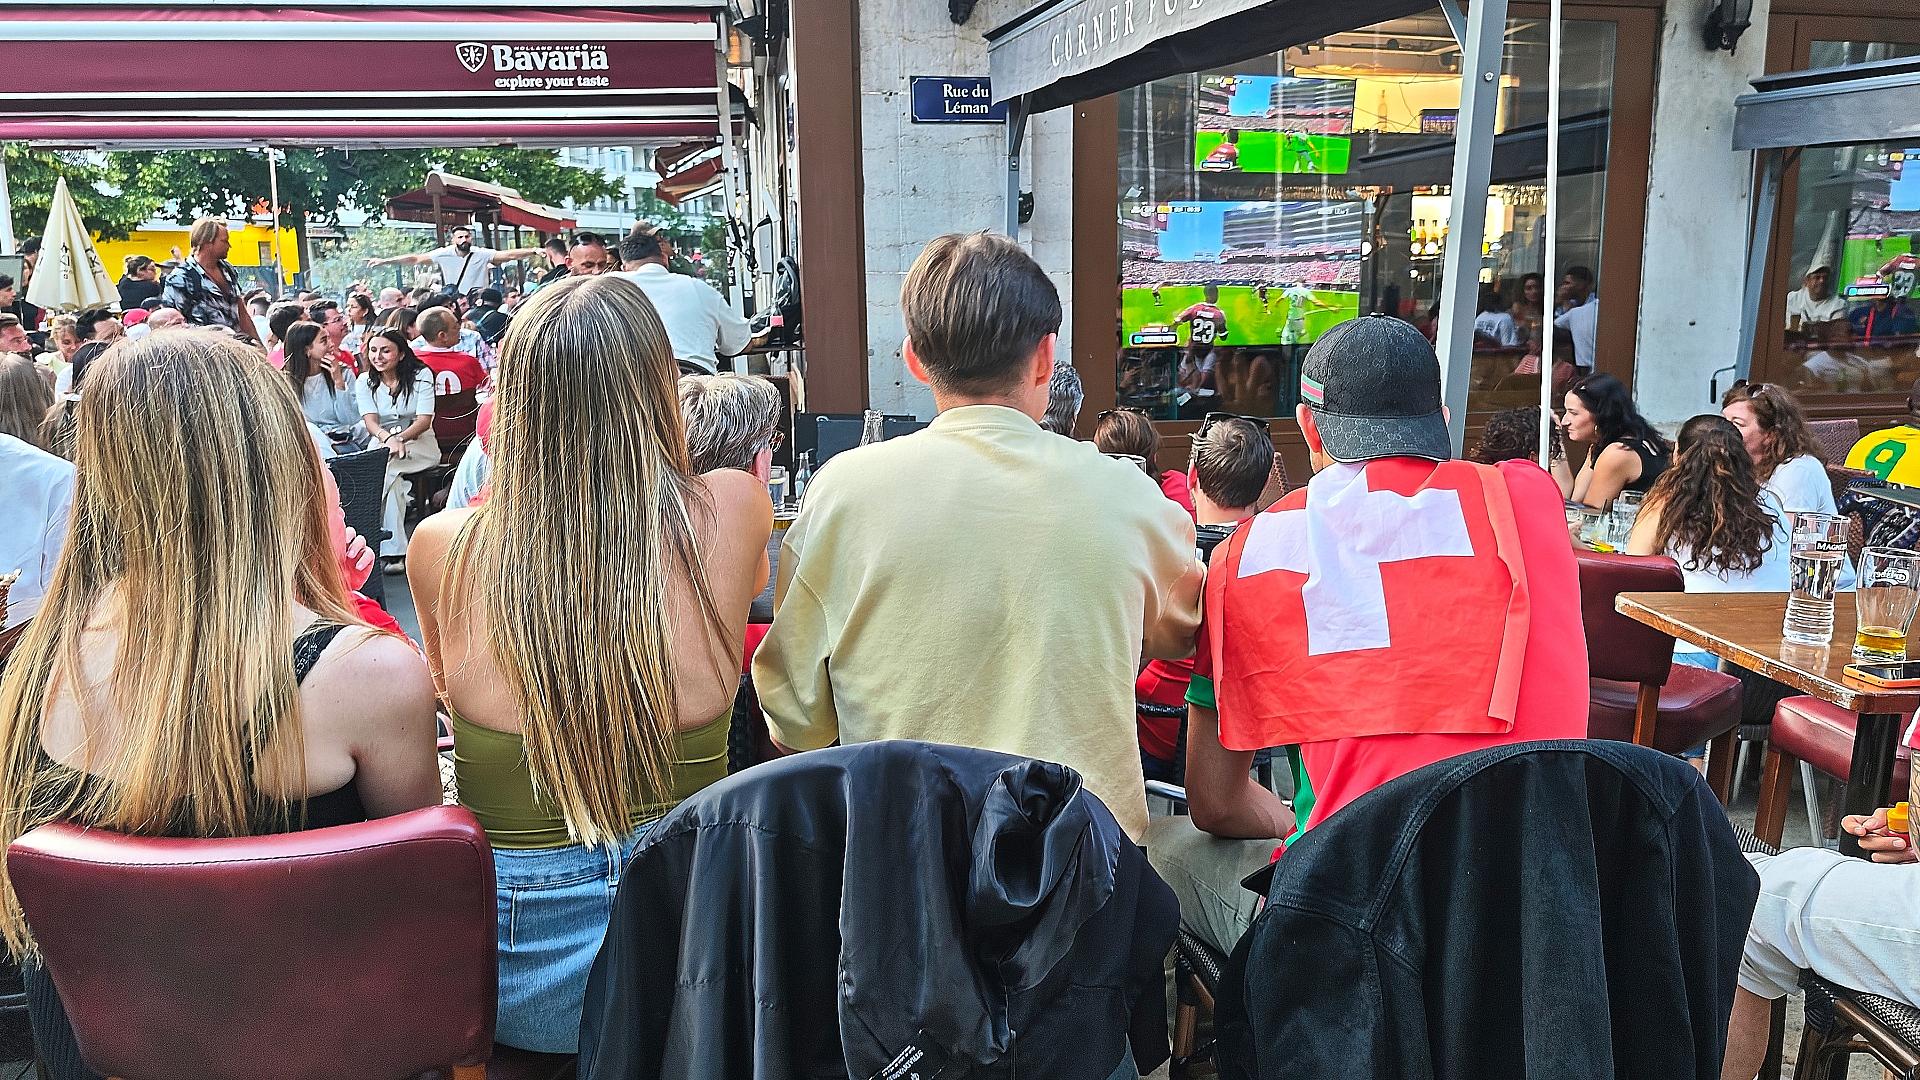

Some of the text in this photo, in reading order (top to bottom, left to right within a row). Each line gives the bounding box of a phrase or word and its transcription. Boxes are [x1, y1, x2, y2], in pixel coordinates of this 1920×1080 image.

[1051, 0, 1135, 67] CORNER
[491, 44, 609, 71] Bavaria
[494, 75, 610, 91] explore your taste
[942, 83, 990, 98] Rue du
[944, 99, 989, 114] Léman
[1865, 439, 1907, 481] 9
